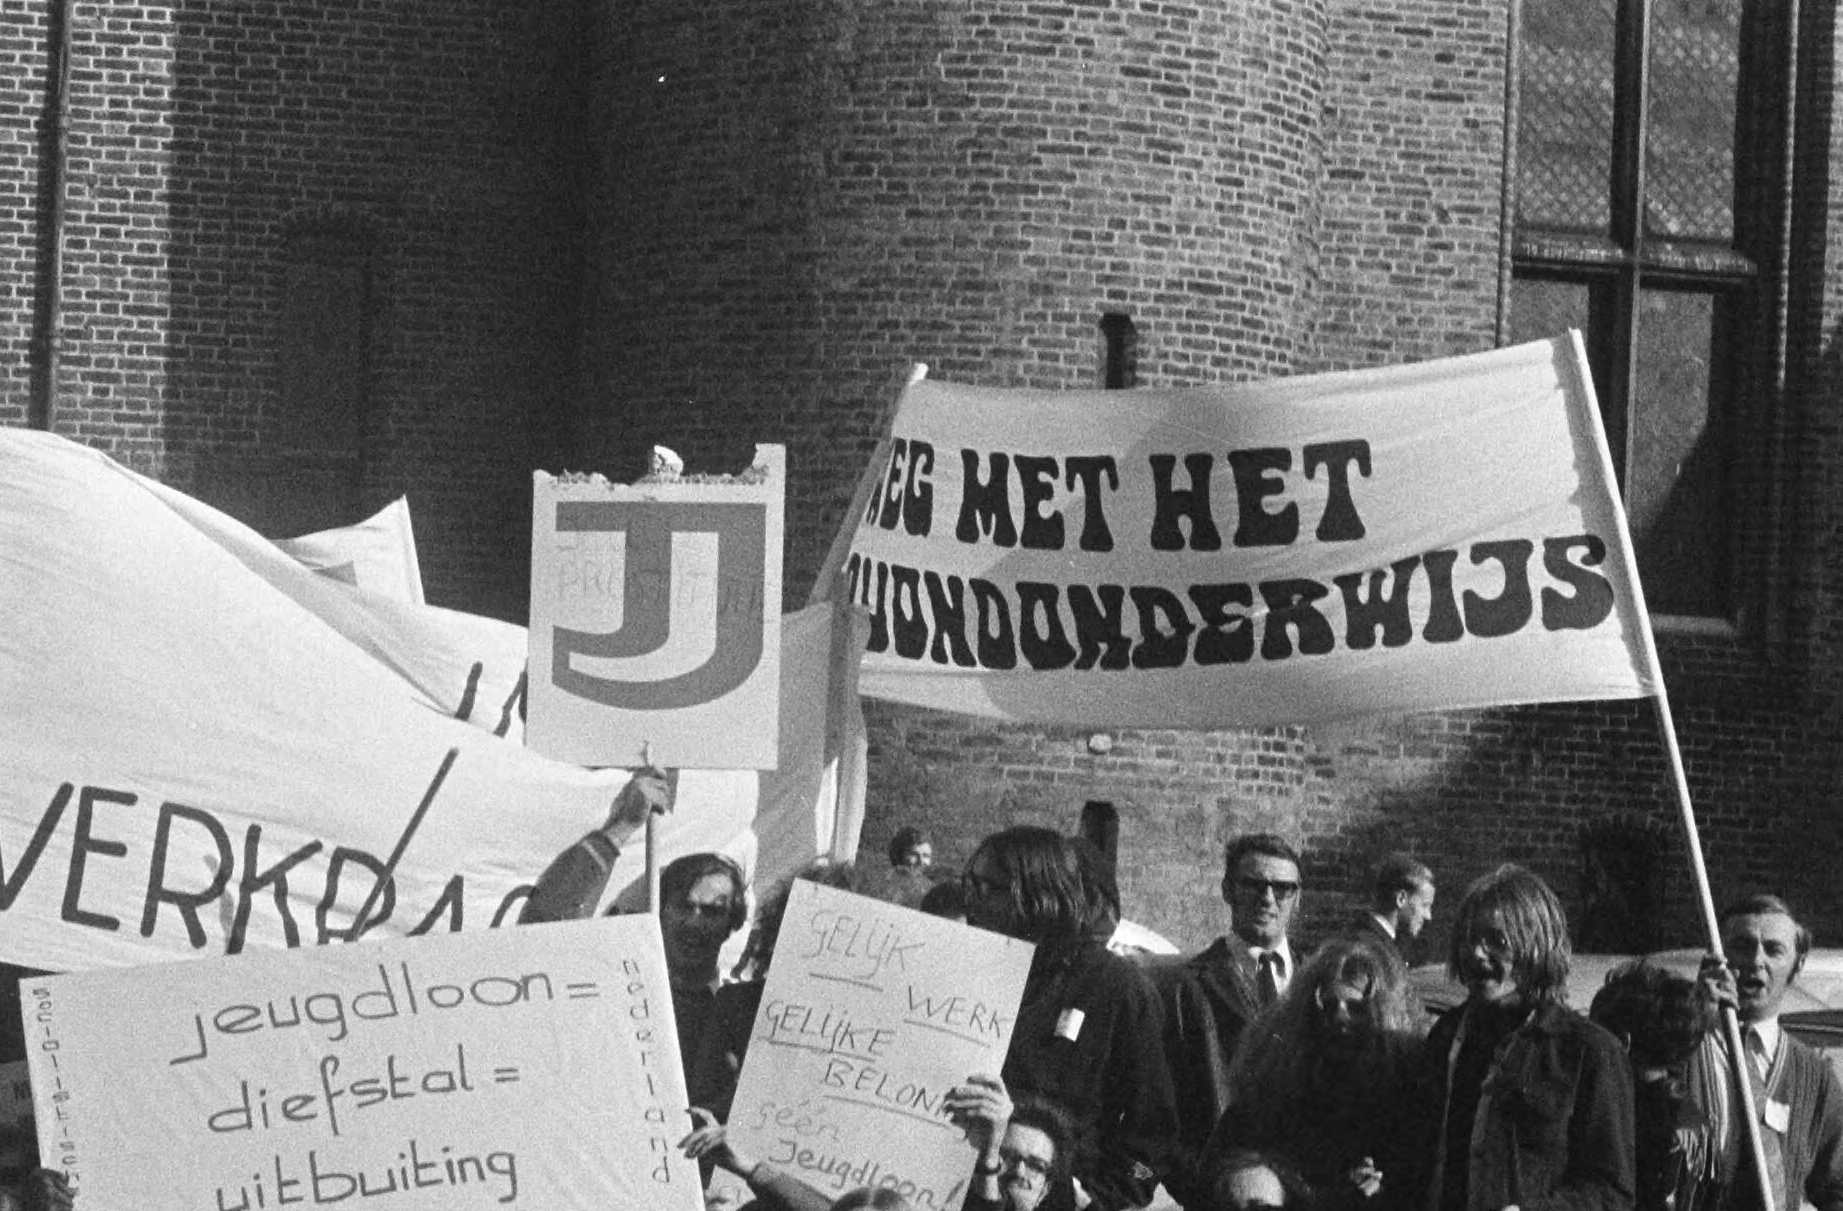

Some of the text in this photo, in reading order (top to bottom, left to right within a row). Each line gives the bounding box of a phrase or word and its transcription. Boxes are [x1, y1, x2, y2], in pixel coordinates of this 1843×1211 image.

[956, 448, 1120, 553] MET
[1148, 438, 1373, 552] HET
[907, 984, 1012, 1038] WERK
[206, 1043, 476, 1138] diefstal
